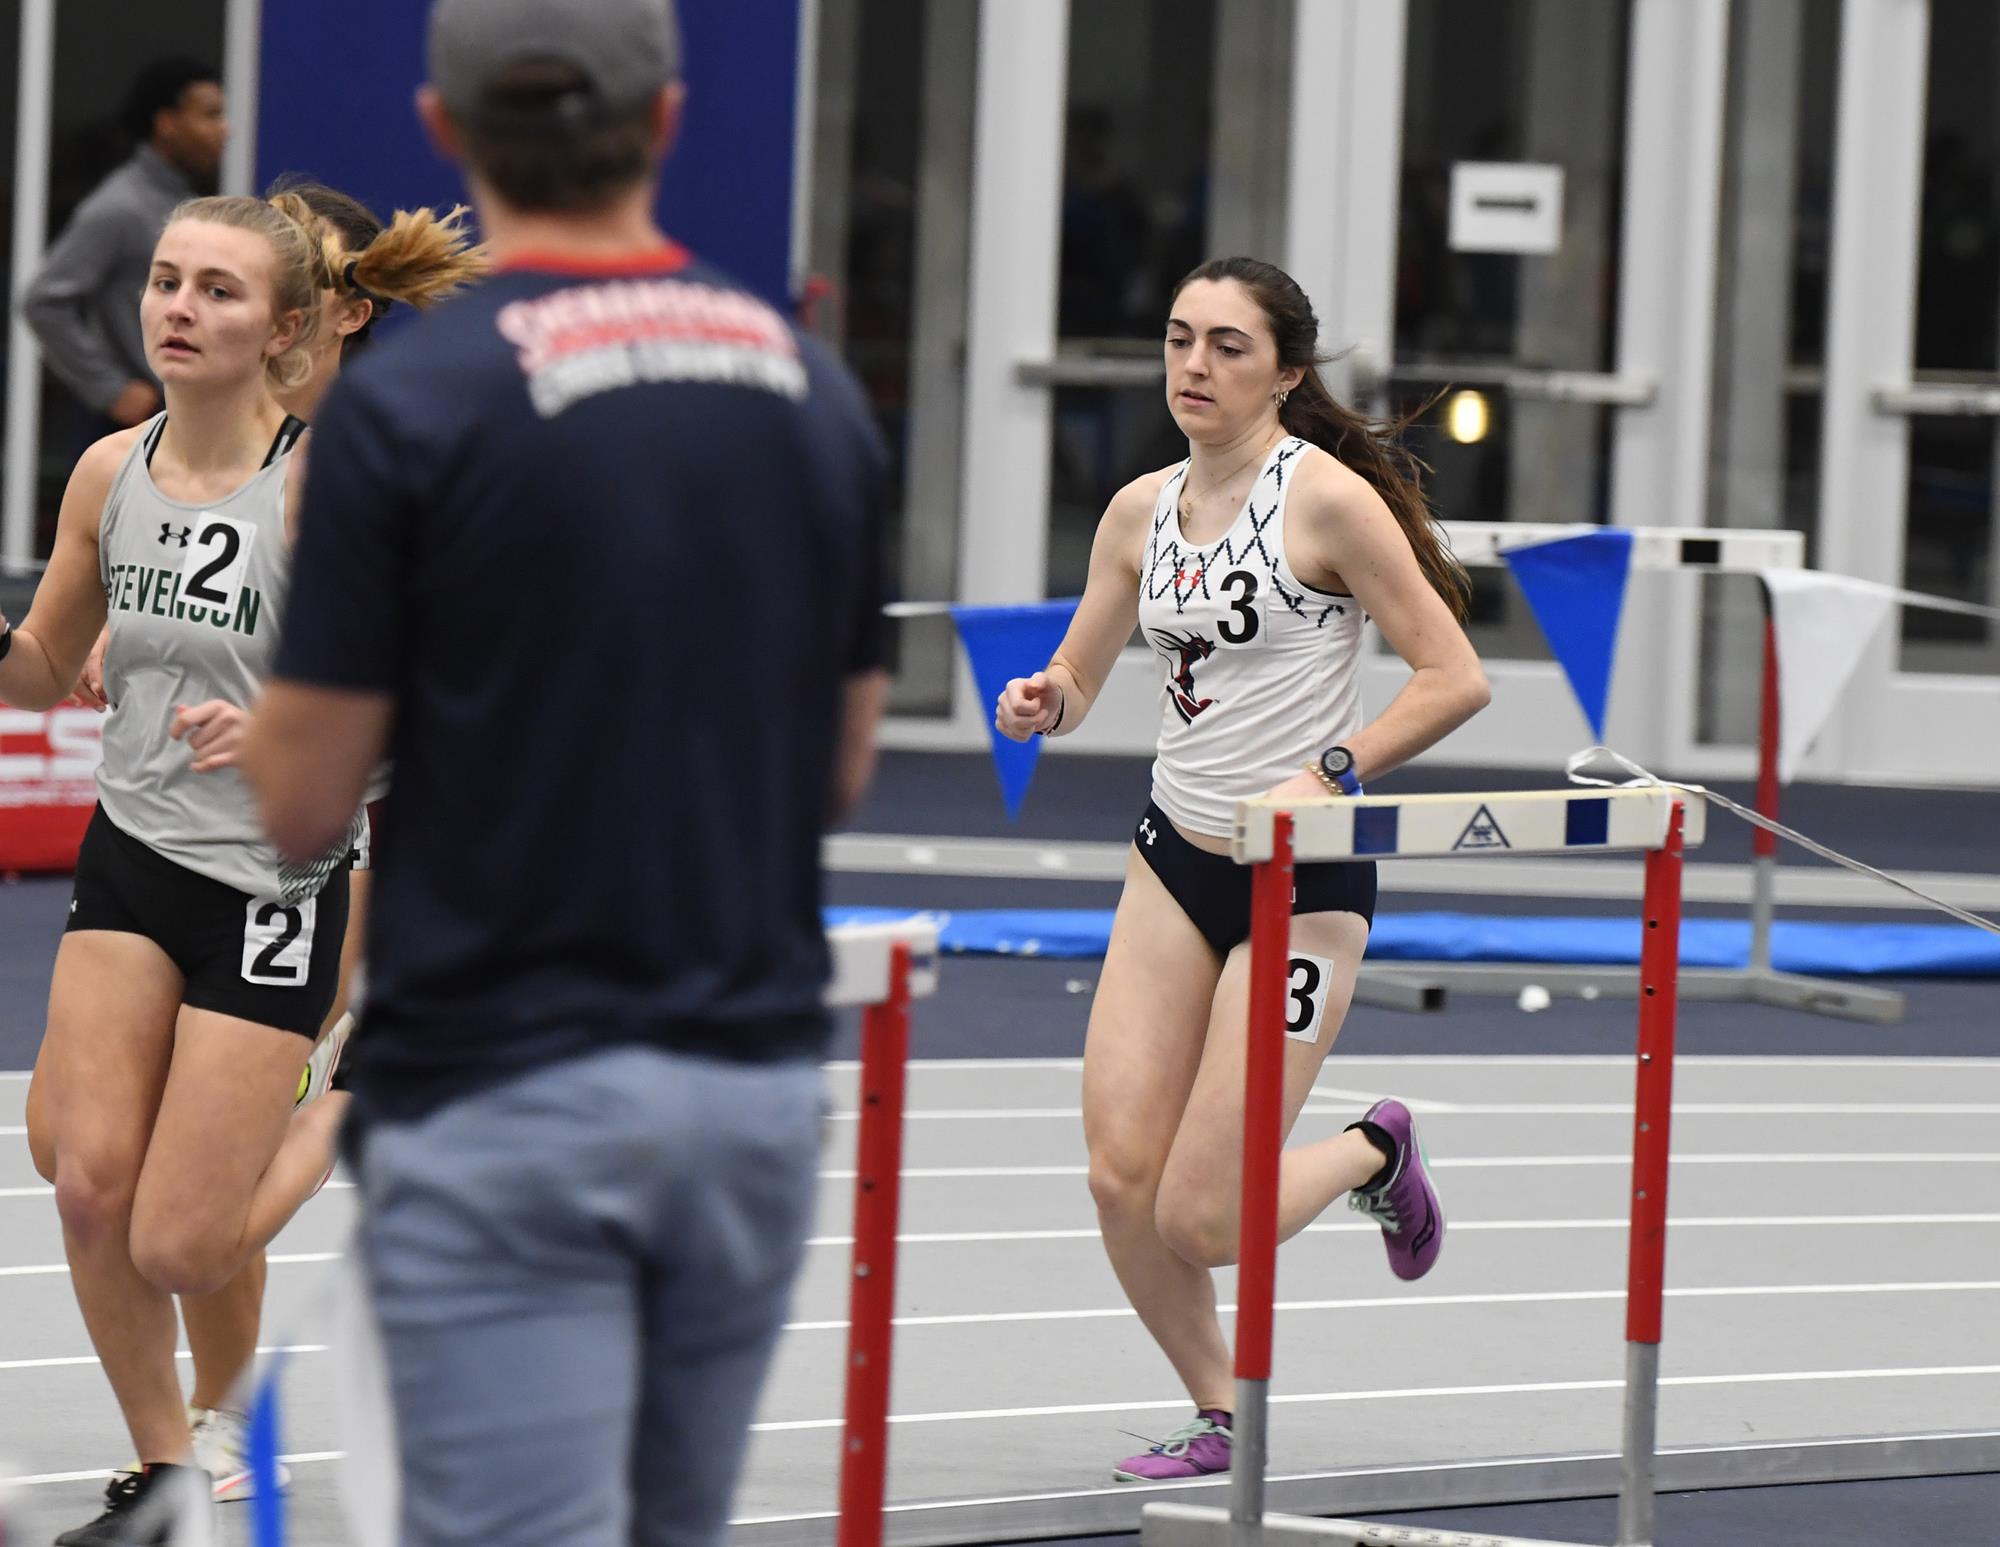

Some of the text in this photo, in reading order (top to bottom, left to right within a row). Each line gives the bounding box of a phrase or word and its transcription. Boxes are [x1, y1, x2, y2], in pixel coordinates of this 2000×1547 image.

[184, 522, 240, 605] 2
[1216, 570, 1259, 644] 3
[250, 902, 302, 979] 2
[1285, 958, 1320, 1033] 3
